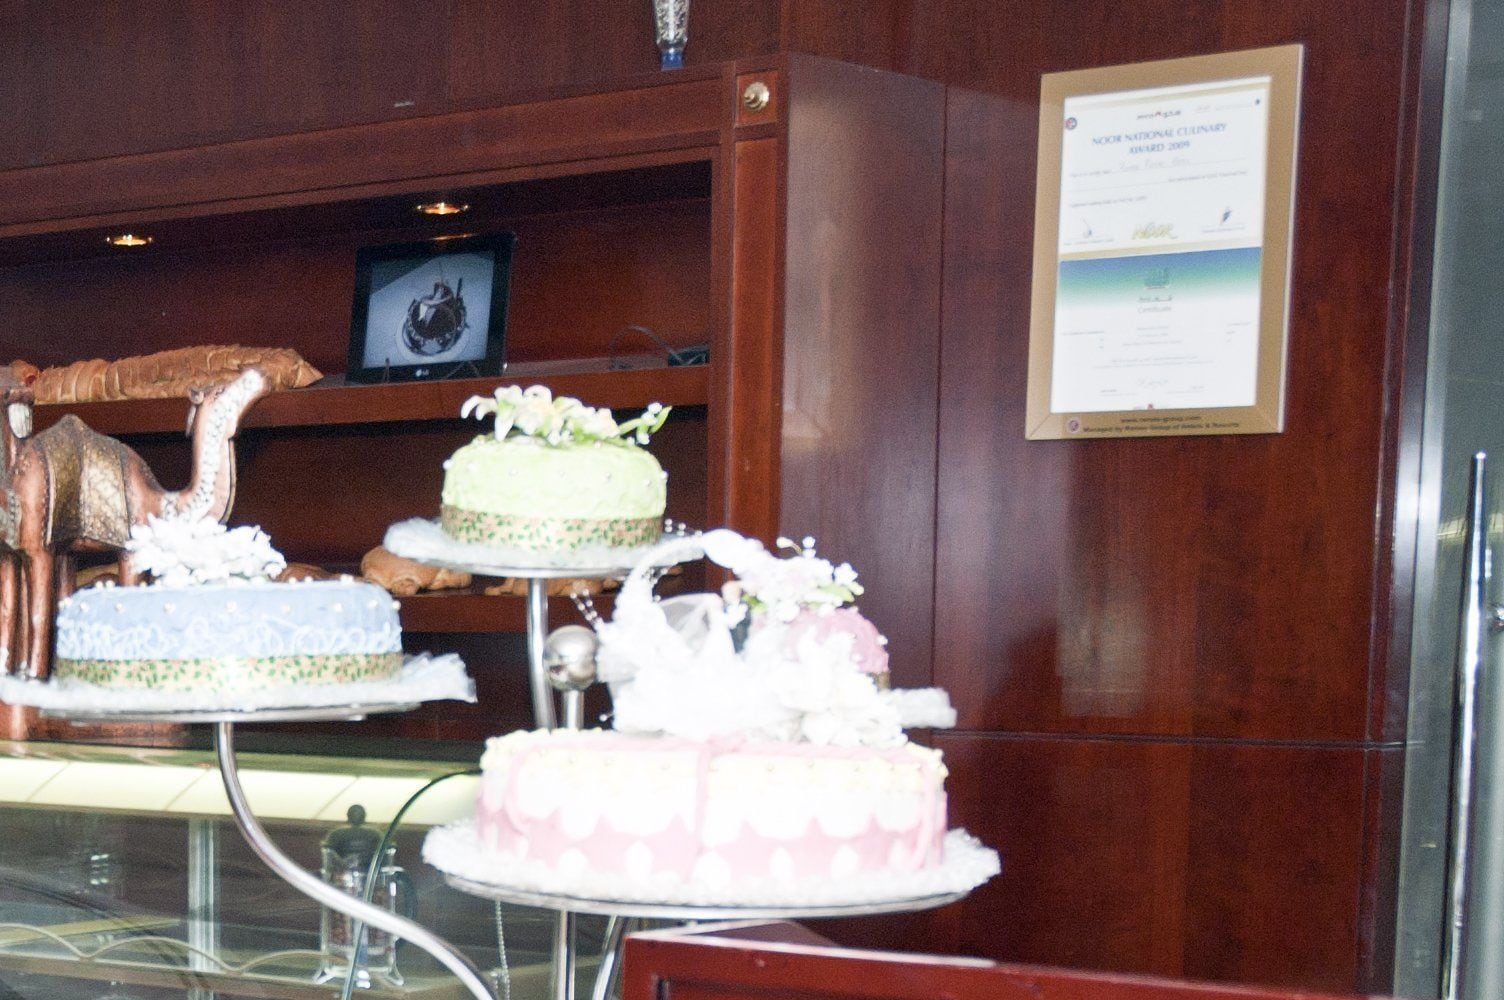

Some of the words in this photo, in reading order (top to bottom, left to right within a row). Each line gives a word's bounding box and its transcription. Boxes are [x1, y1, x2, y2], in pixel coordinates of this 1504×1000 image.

[1091, 134, 1122, 146] NOOR
[1124, 128, 1174, 143] NATIONAL
[1176, 121, 1228, 137] CULINARY
[1128, 143, 1165, 155] AWARD
[1168, 139, 1191, 151] 2009
